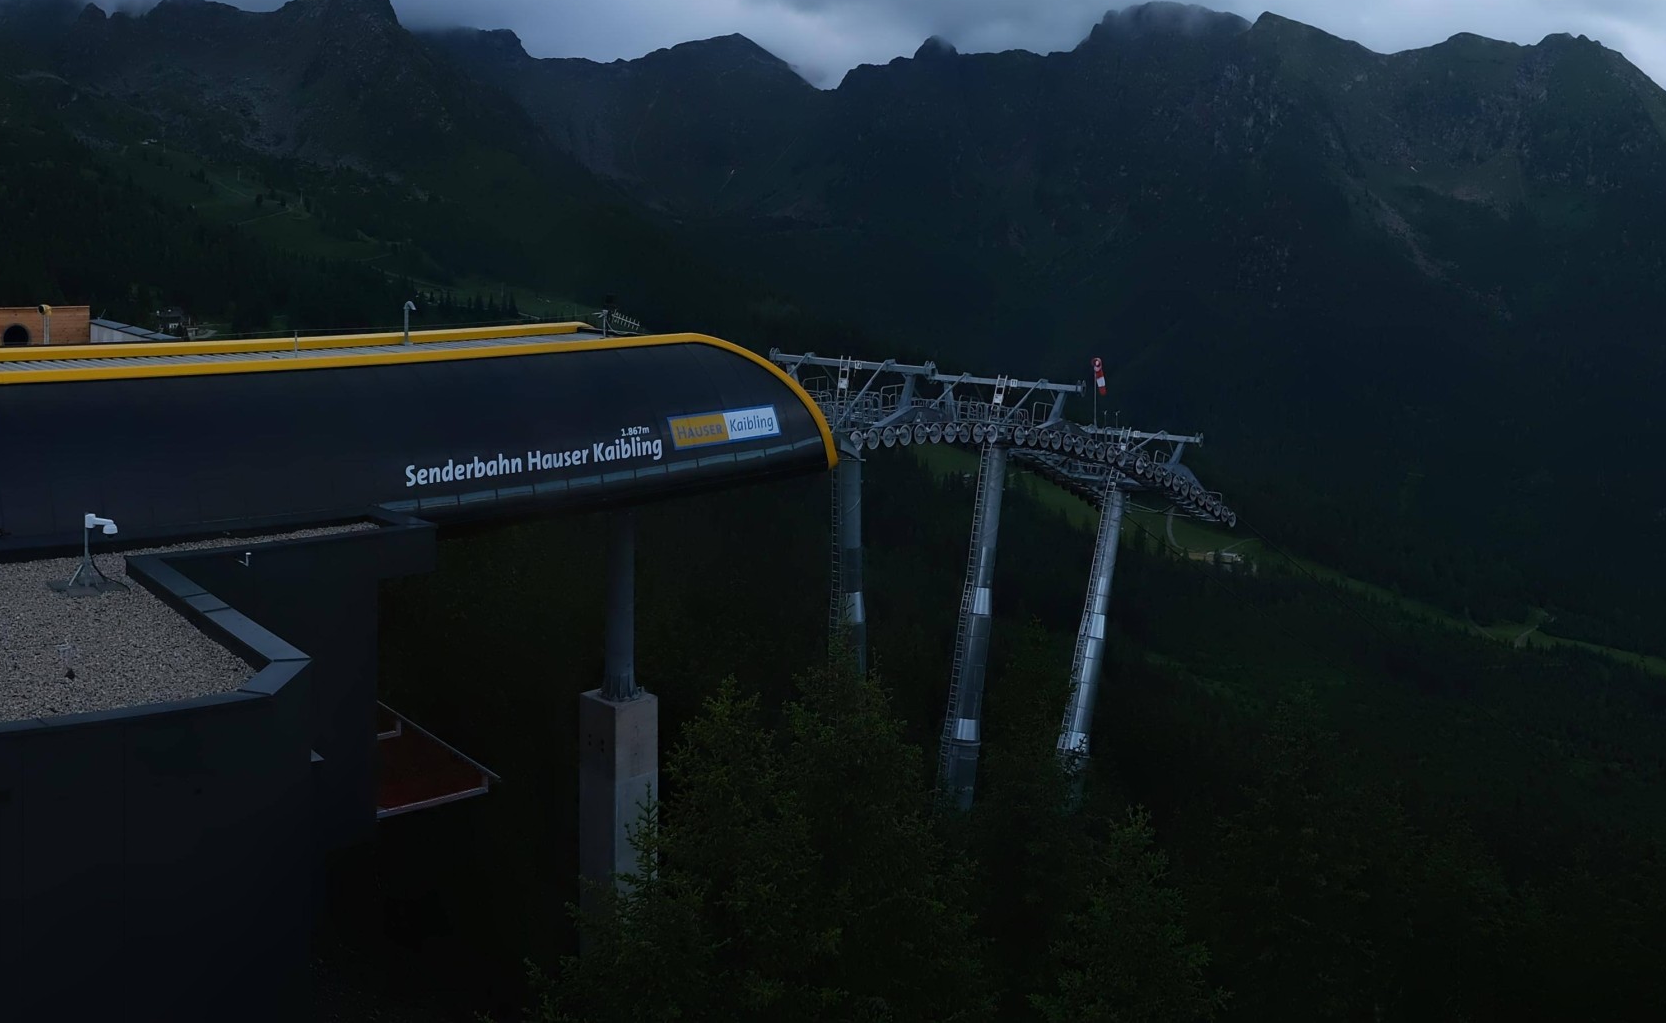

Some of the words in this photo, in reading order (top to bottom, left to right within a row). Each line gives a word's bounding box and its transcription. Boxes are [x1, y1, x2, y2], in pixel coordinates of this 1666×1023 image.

[621, 425, 650, 437] 1.867m
[677, 424, 723, 439] HAUSER
[729, 415, 774, 432] Kaibling
[405, 453, 522, 487] Senderbahn
[527, 446, 589, 472] Hauser
[593, 437, 663, 463] Kaibling
